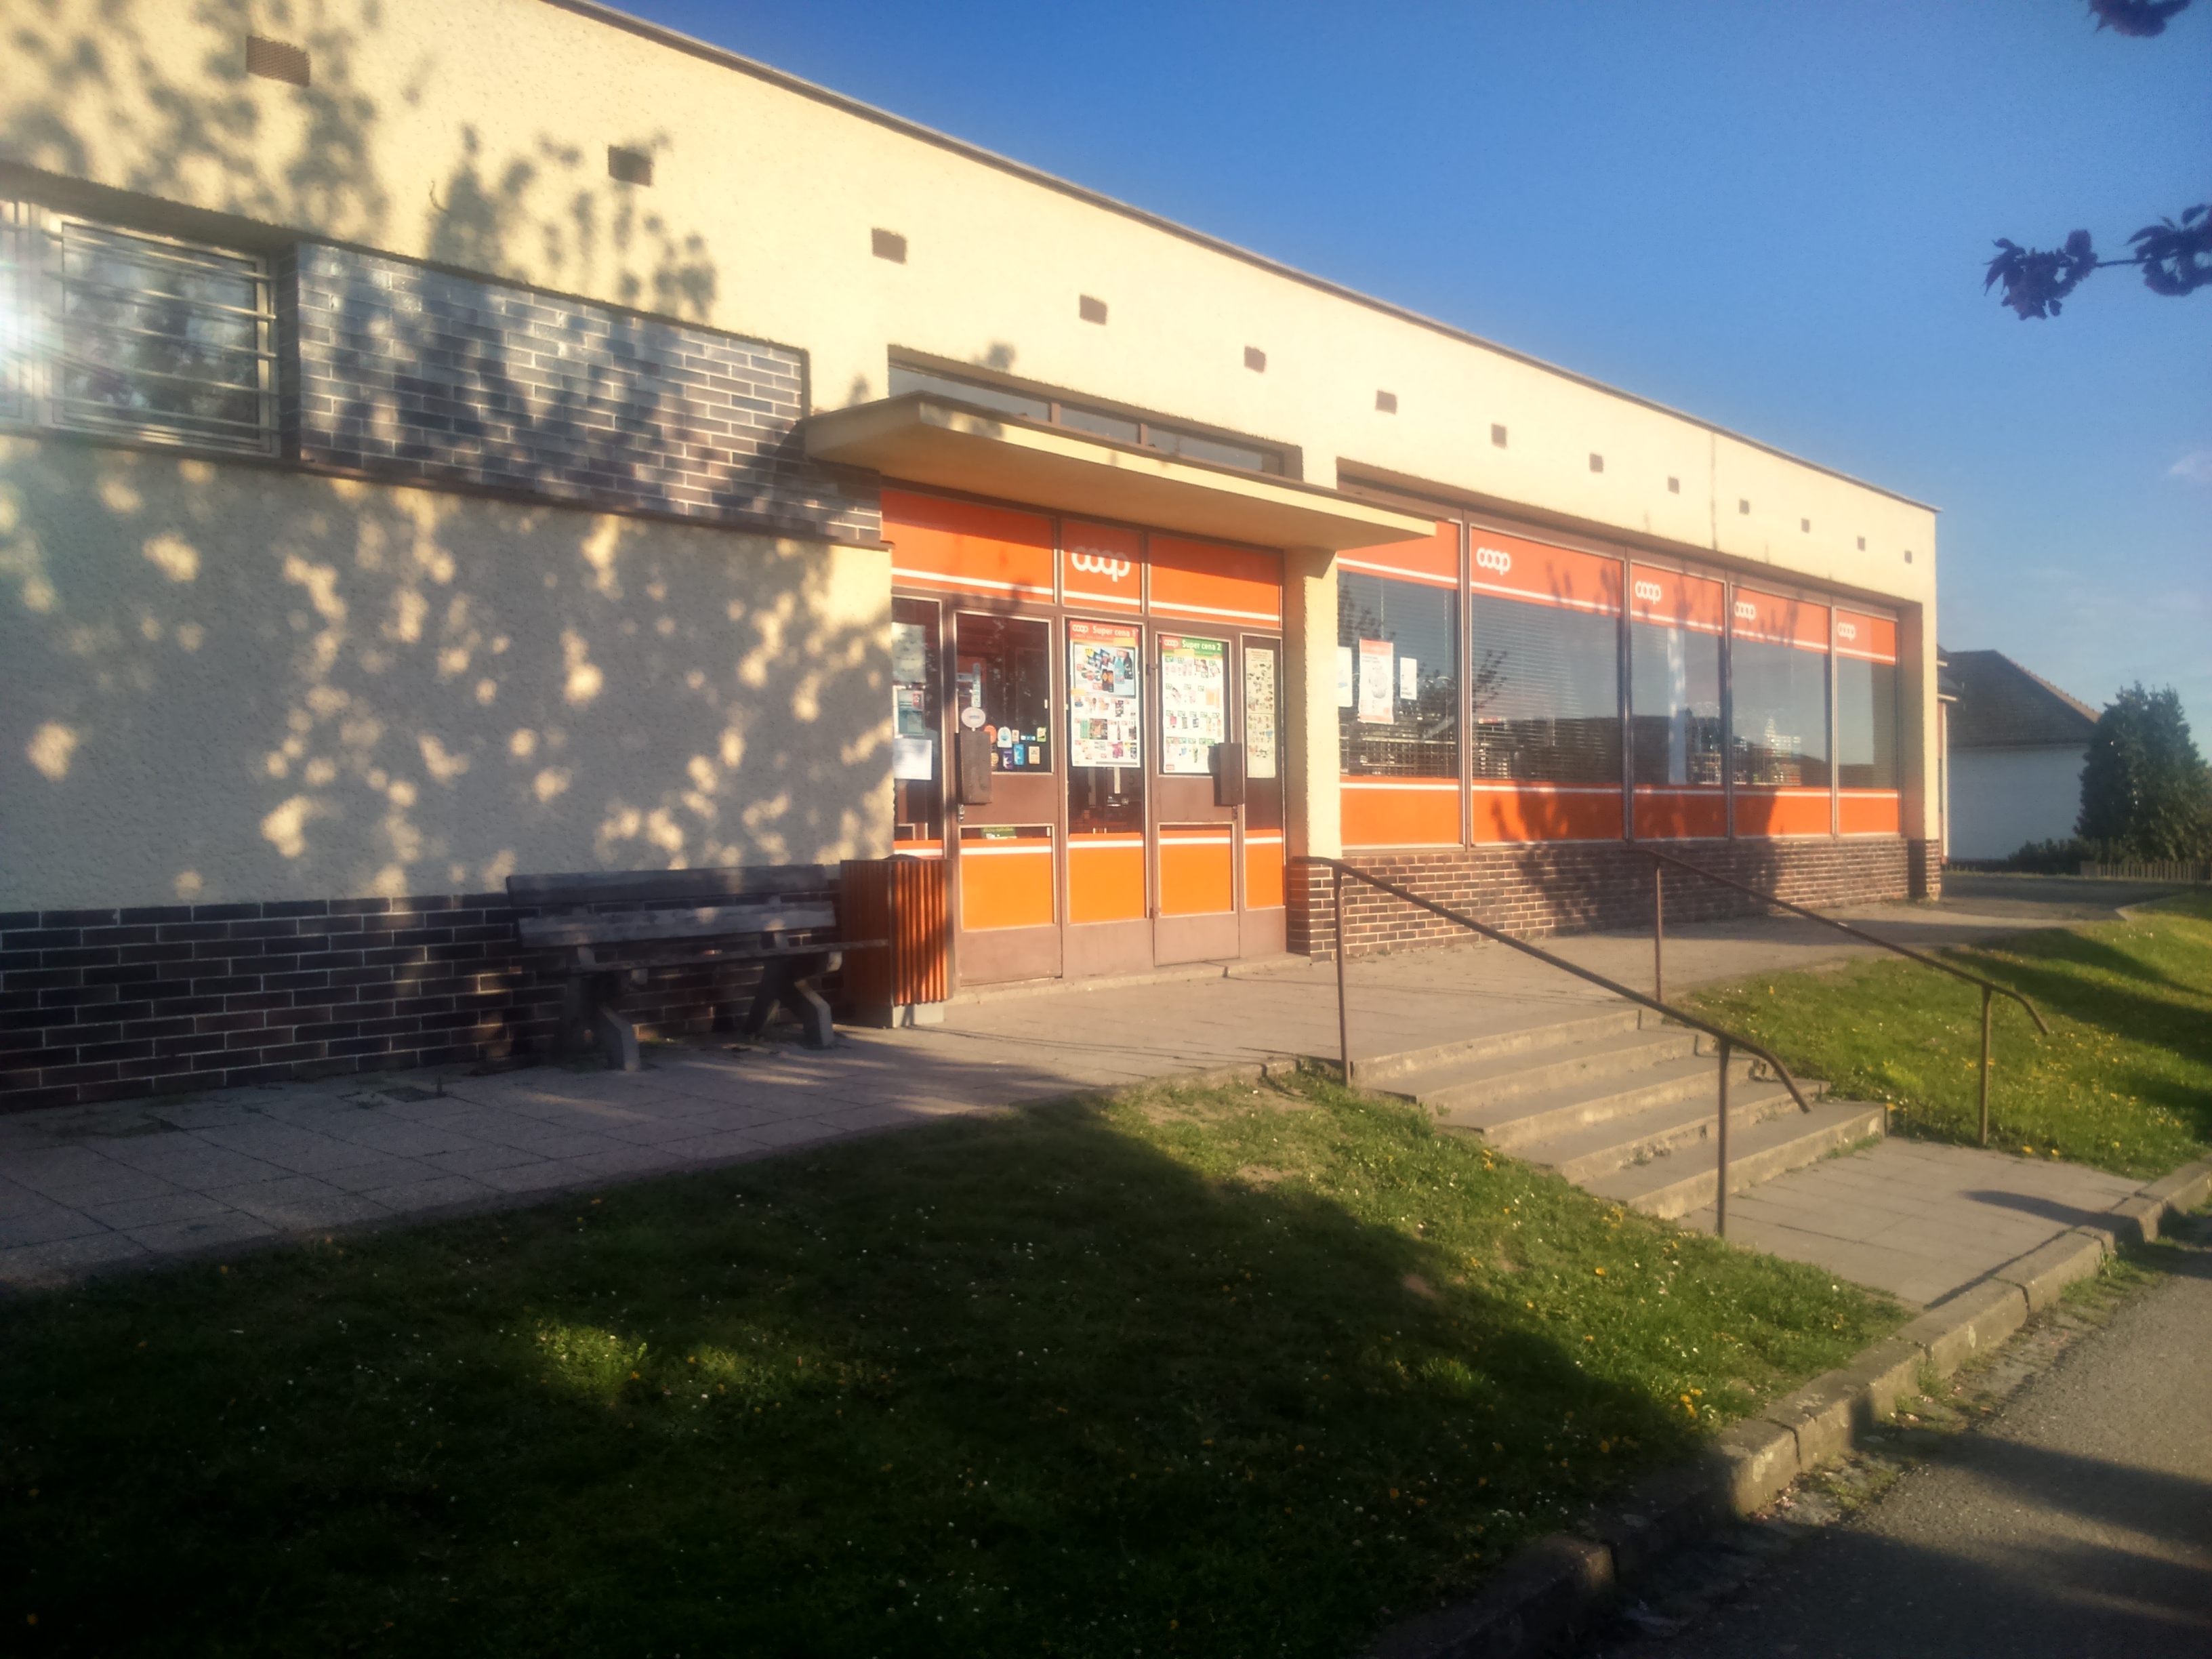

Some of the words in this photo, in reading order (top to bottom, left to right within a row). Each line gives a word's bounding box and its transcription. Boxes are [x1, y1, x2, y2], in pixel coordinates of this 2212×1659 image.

[1071, 546, 1130, 582] coop
[1476, 548, 1511, 575] coop
[1635, 580, 1662, 605] coop
[1734, 602, 1756, 621] coop
[1072, 624, 1089, 634] coop
[1092, 626, 1113, 636] Super
[1114, 629, 1130, 637] cena
[1837, 622, 1856, 642] coop
[1164, 639, 1179, 649] coop
[1182, 640, 1200, 649] Super
[1201, 642, 1216, 651] cena
[1216, 642, 1221, 651] 2
